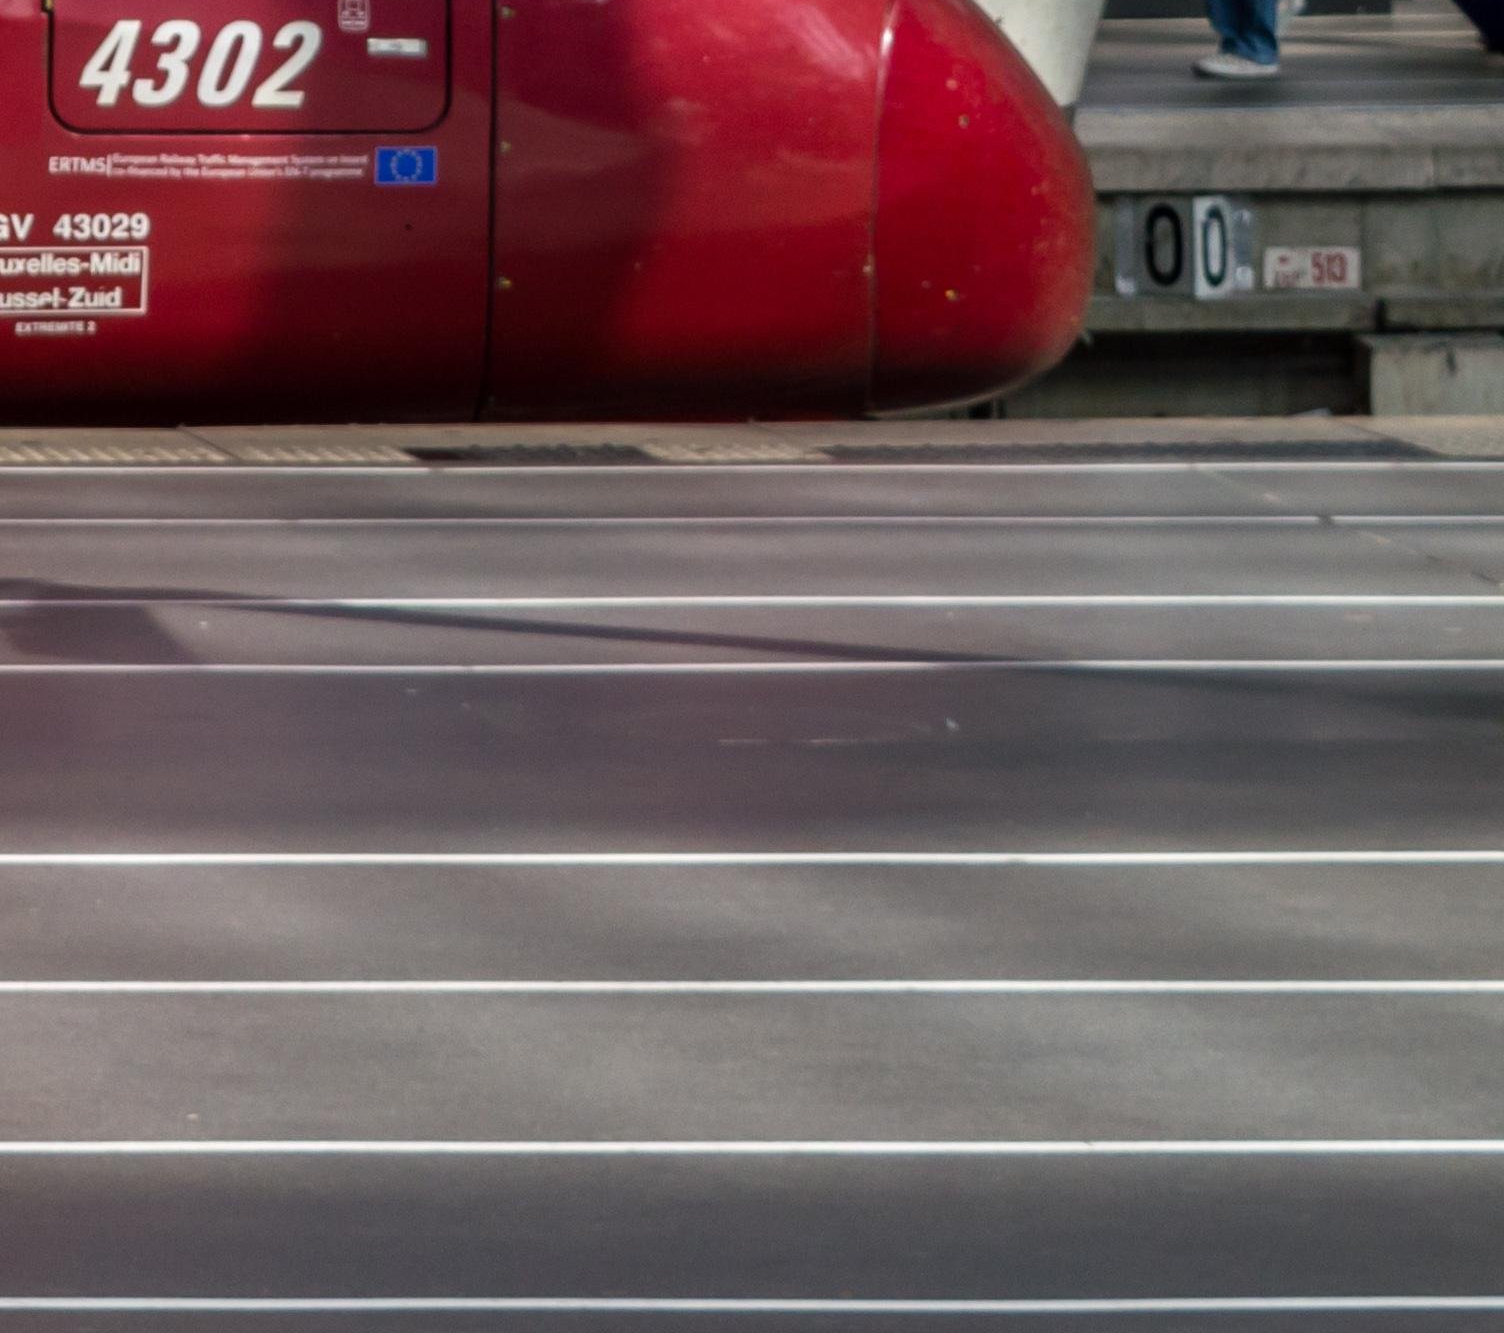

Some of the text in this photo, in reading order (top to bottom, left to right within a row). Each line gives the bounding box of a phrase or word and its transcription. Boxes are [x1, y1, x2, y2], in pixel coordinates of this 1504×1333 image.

[78, 19, 323, 108] 4302
[48, 156, 106, 174] ERTMS
[52, 213, 150, 240] 43029
